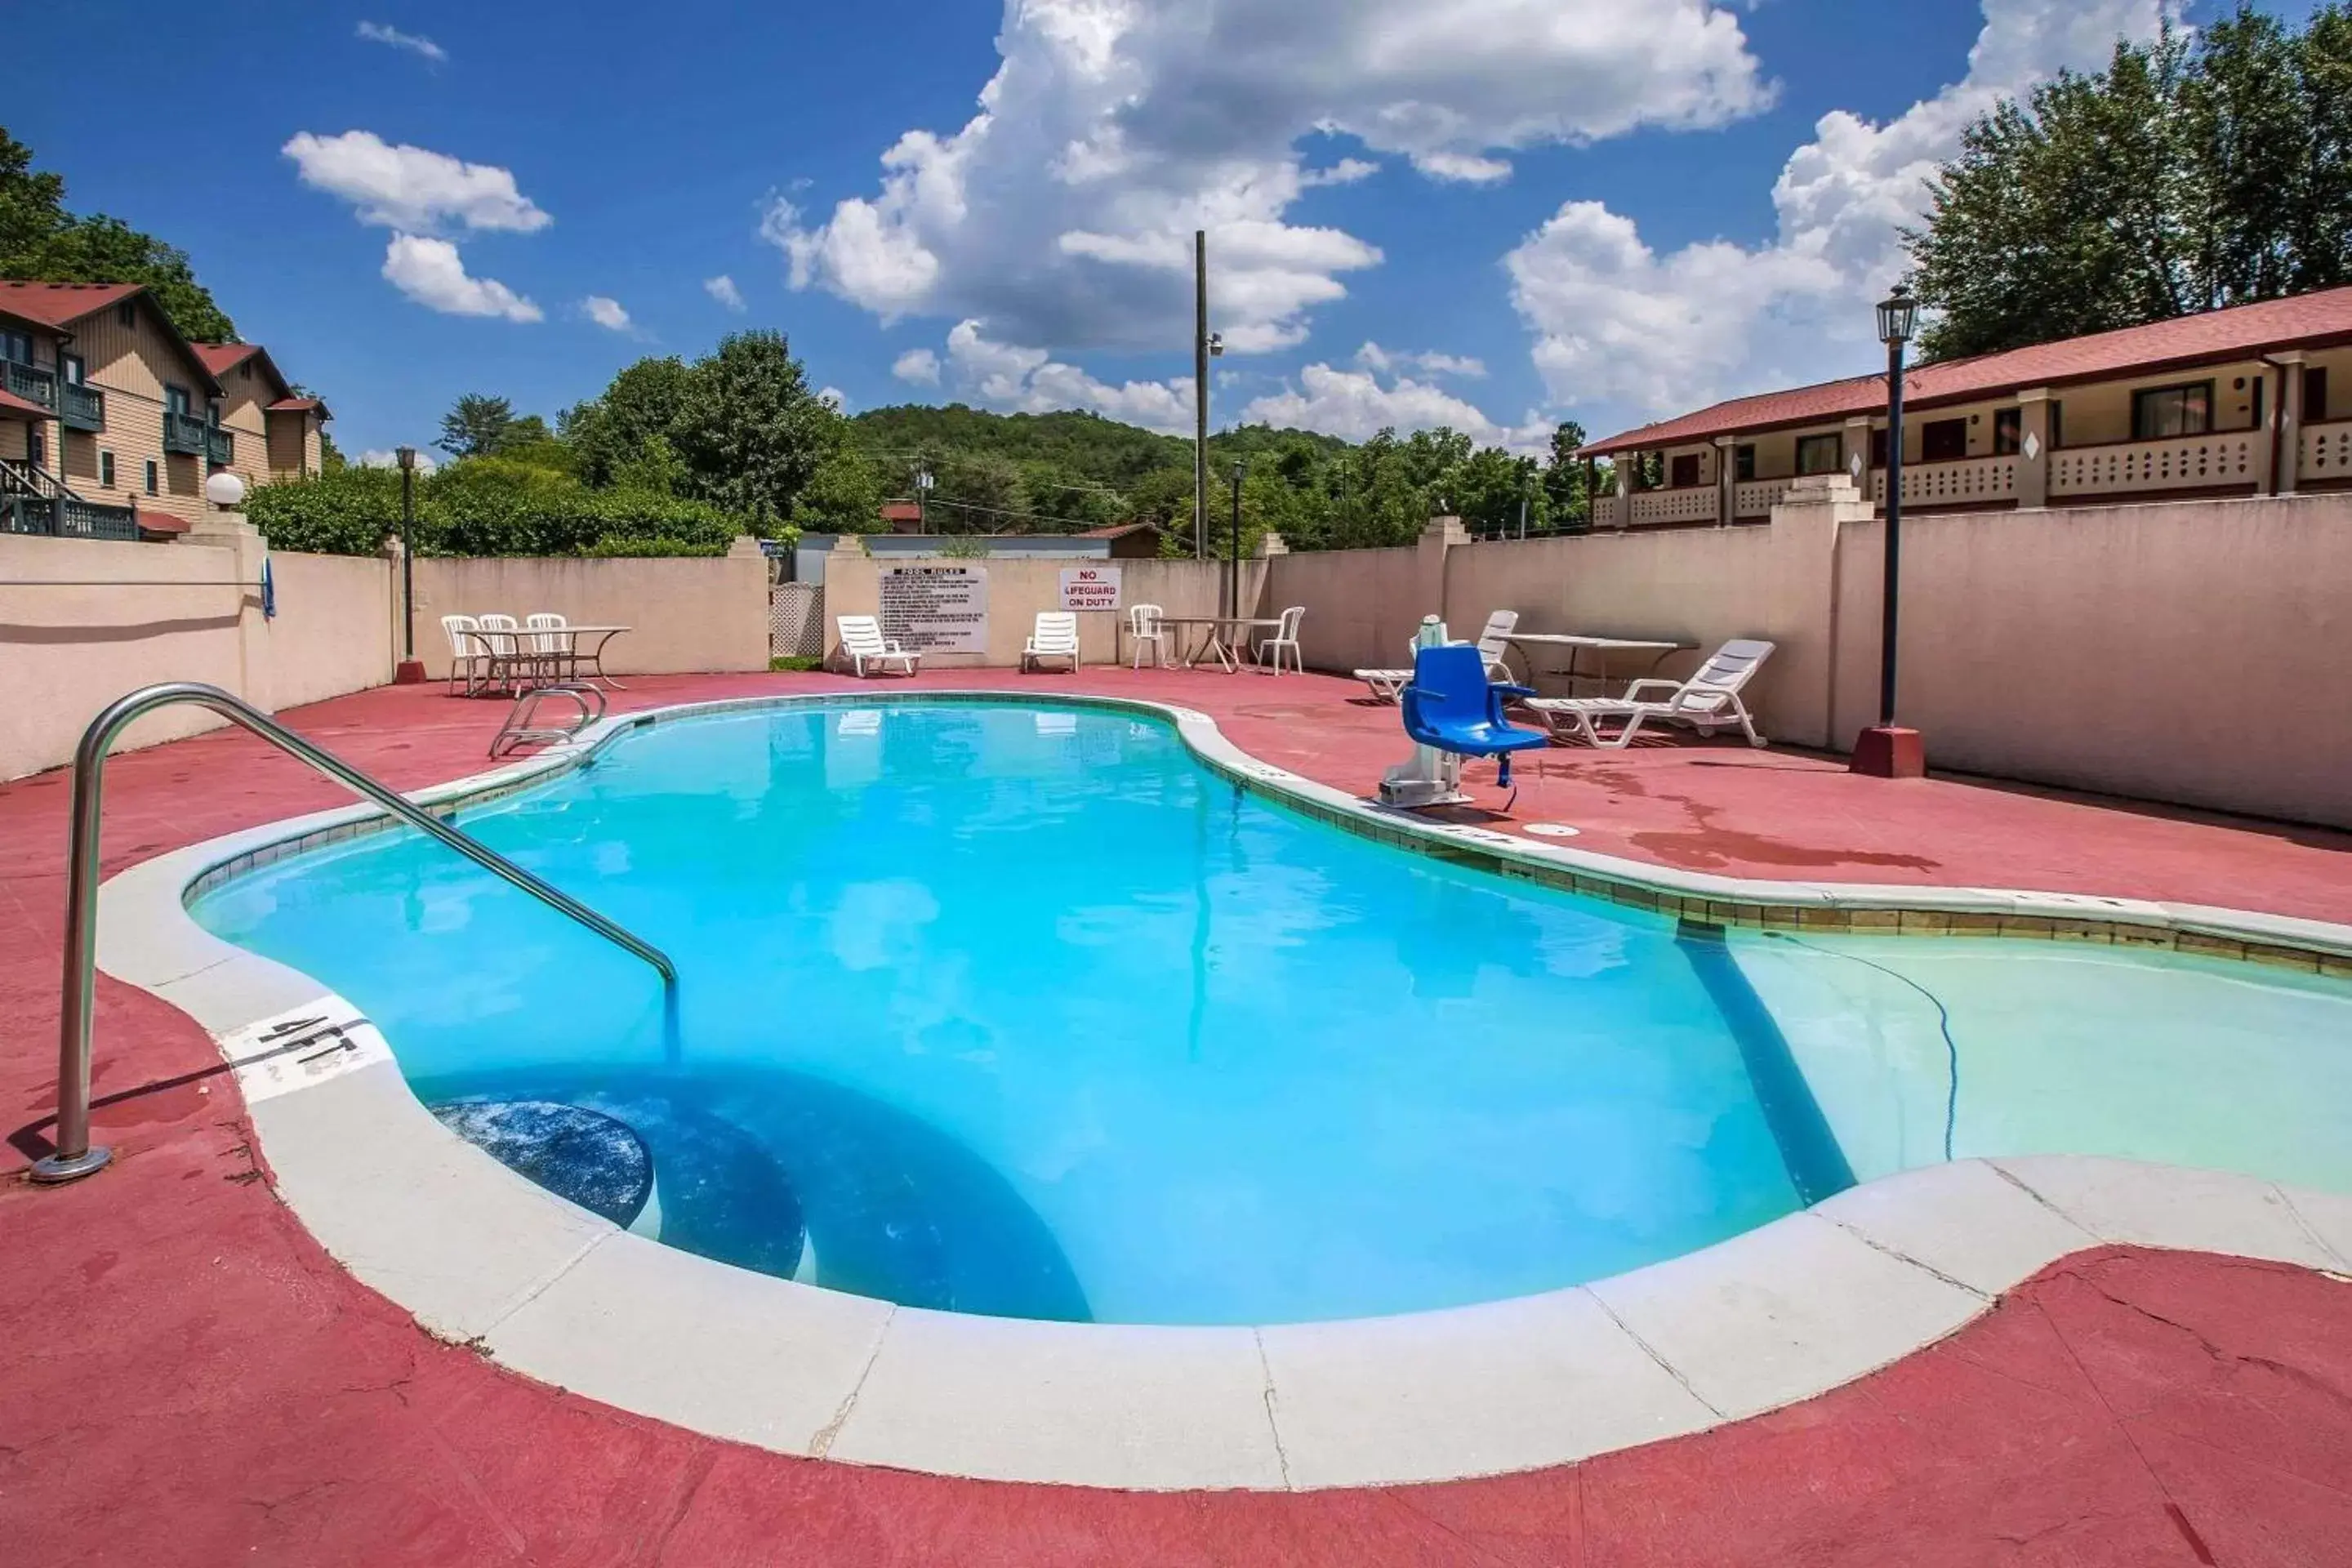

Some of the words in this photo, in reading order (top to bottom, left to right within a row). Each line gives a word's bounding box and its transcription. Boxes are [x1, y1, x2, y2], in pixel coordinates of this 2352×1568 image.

[1080, 571, 1097, 580] NO
[1065, 586, 1116, 595] LIFEGUARD
[1069, 598, 1084, 606] ON
[1086, 598, 1115, 607] DUTY
